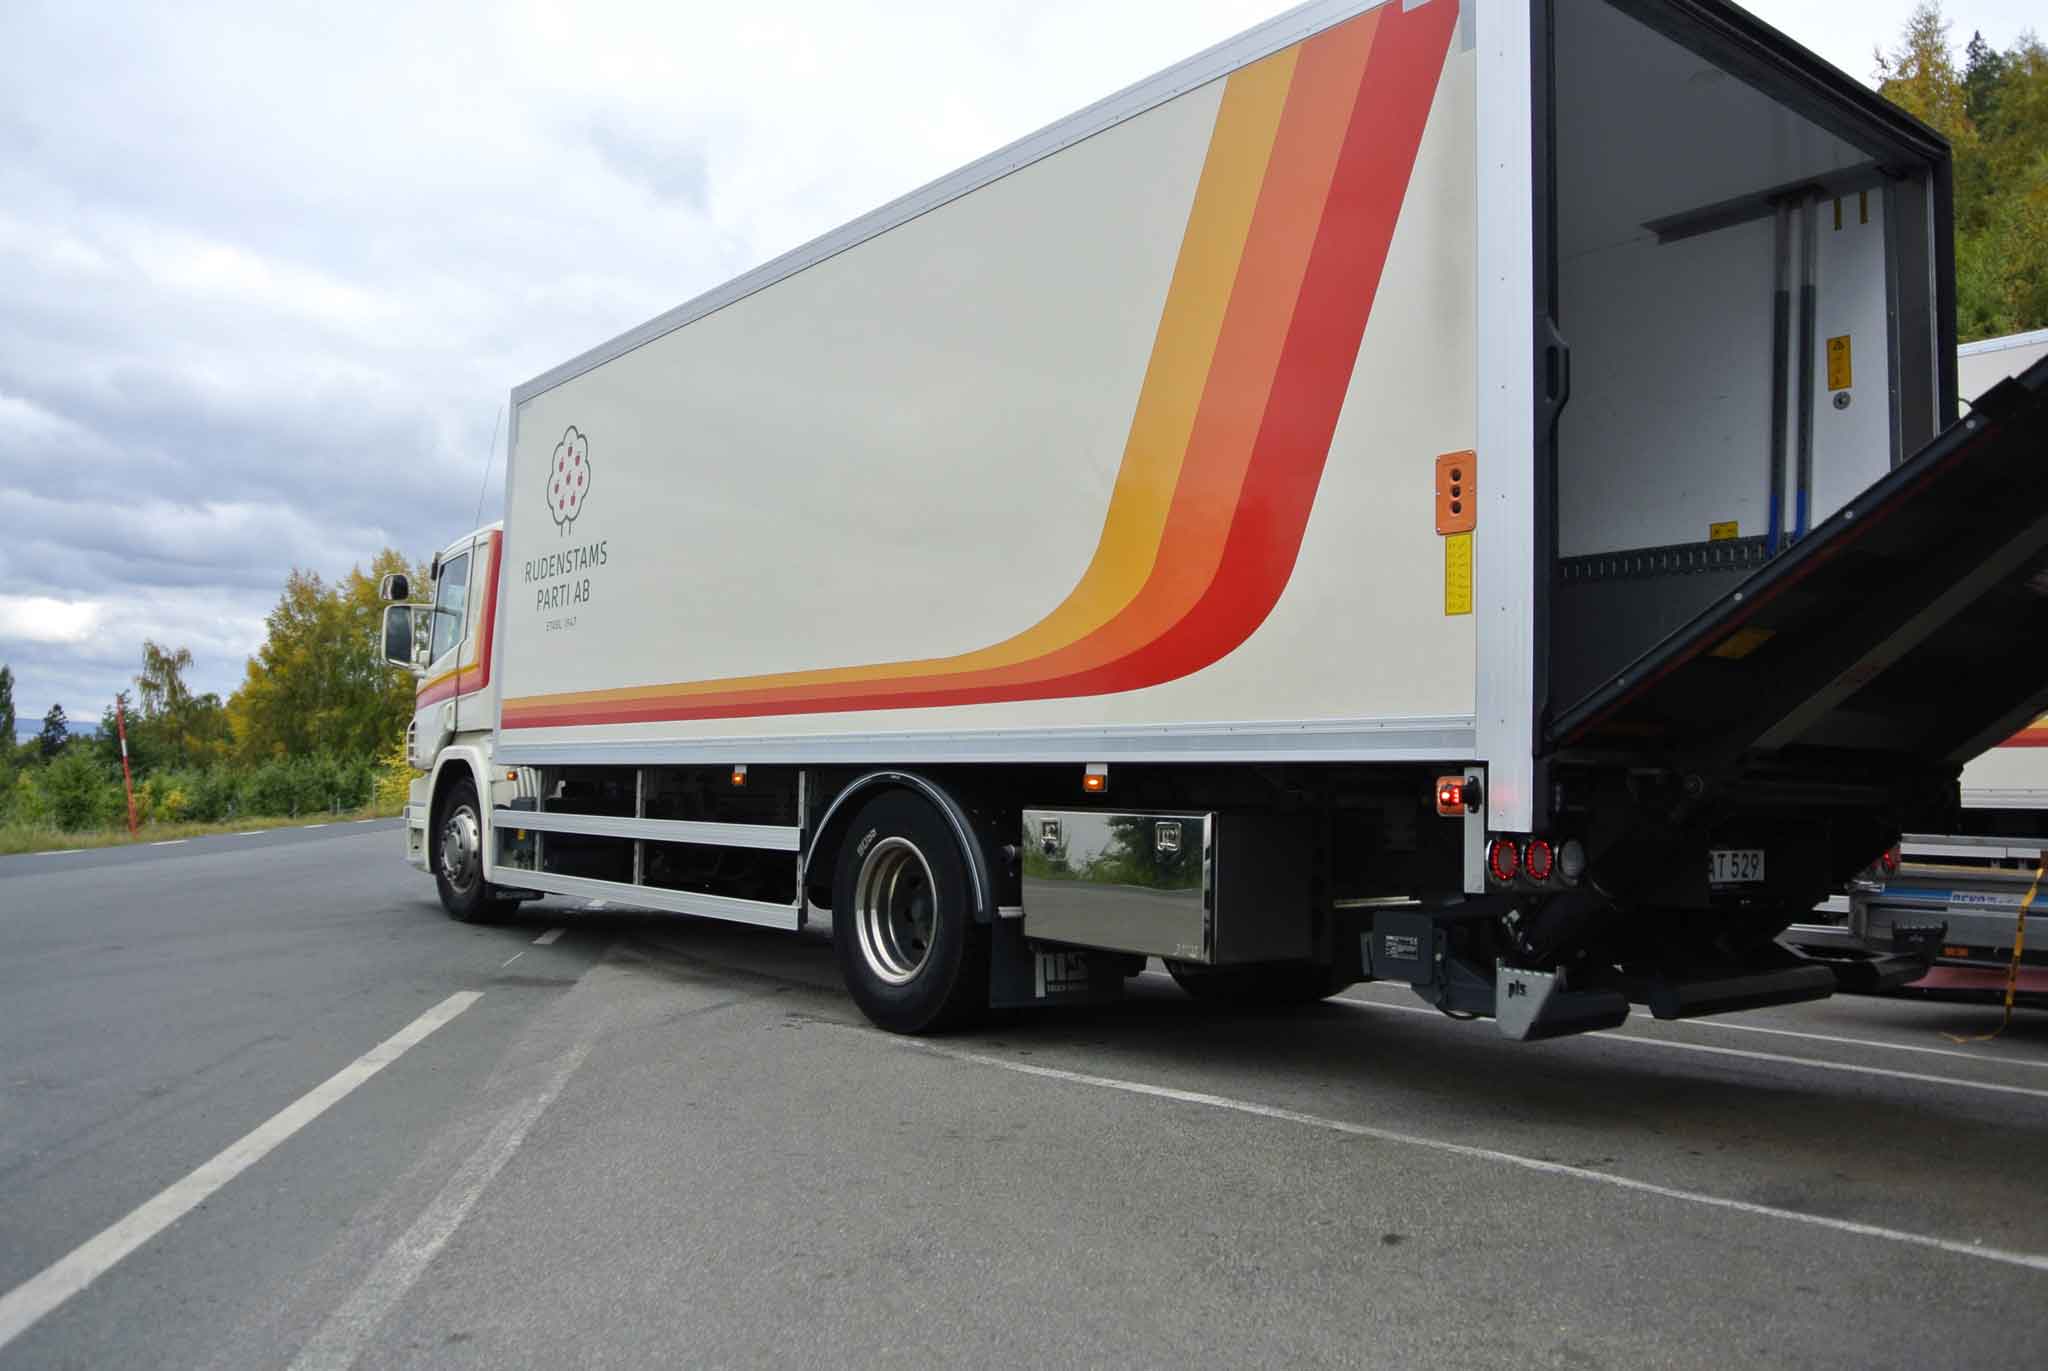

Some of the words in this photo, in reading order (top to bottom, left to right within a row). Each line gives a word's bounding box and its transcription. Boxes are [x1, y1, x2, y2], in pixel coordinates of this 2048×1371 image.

[525, 540, 608, 584] RUDENSTAMS
[536, 583, 571, 613] PARTI
[573, 578, 591, 605] AB
[1731, 853, 1760, 880] 529
